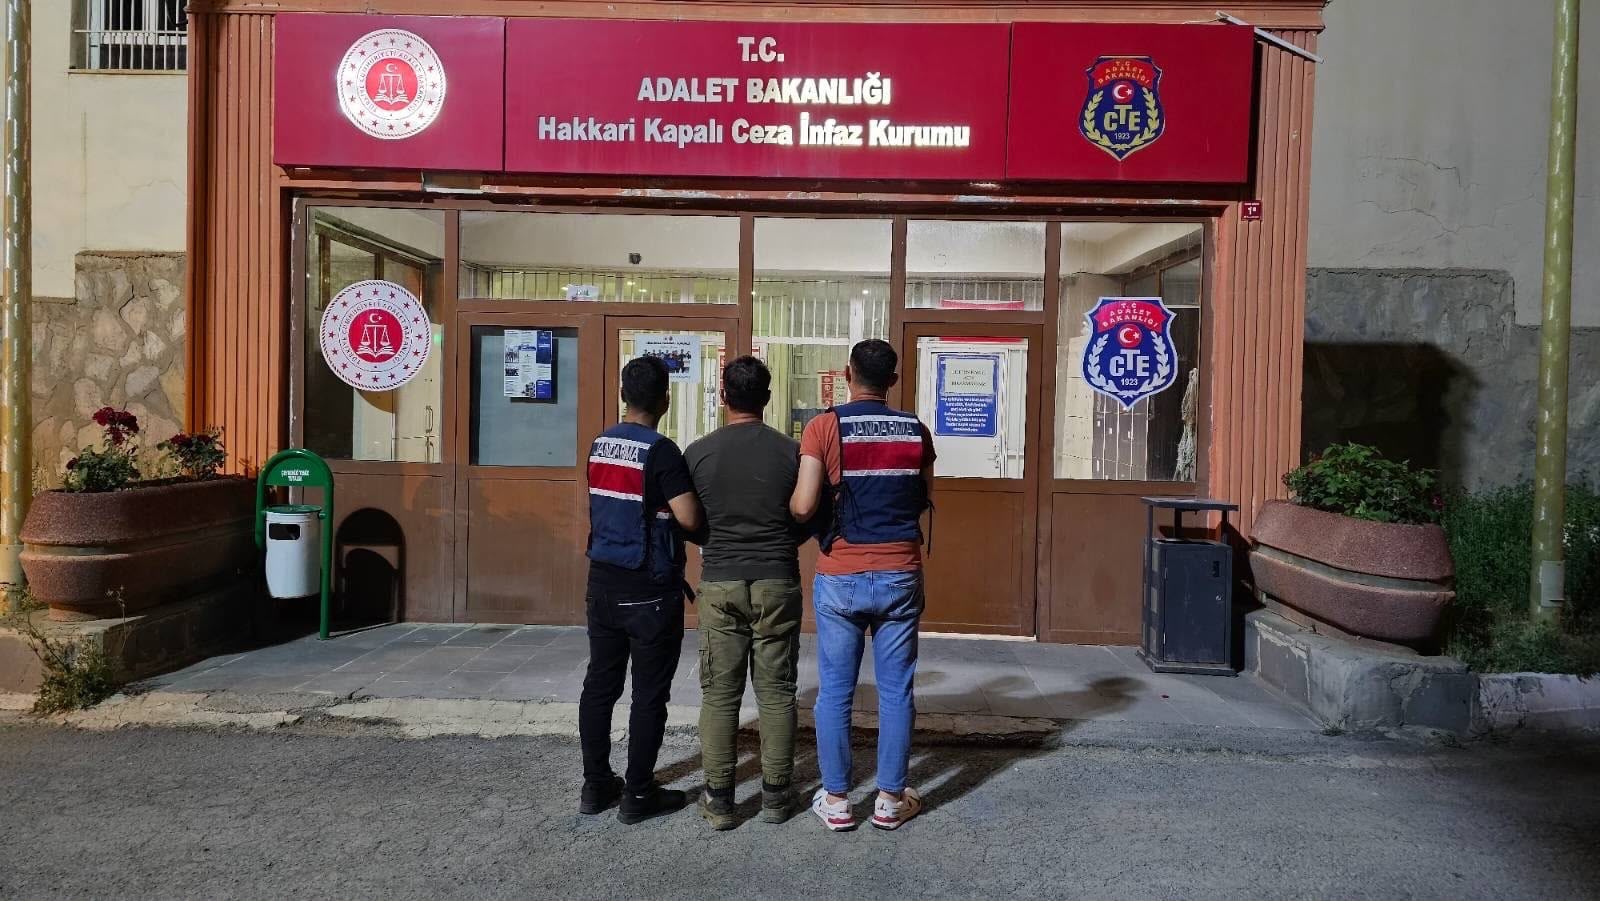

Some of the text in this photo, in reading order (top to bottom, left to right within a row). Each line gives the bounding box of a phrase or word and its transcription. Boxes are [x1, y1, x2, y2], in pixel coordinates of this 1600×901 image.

[737, 36, 785, 63] T.C.
[637, 72, 892, 105] ADALET BAKANLIĞI
[538, 111, 971, 149] Hakkari Kapalı Ceza İnfaz Kurumu
[1104, 105, 1140, 131] CTE
[1114, 132, 1131, 140] 1923
[1110, 309, 1152, 317] ADALET
[1110, 349, 1149, 377] CTE
[849, 421, 914, 436] JANDARMA
